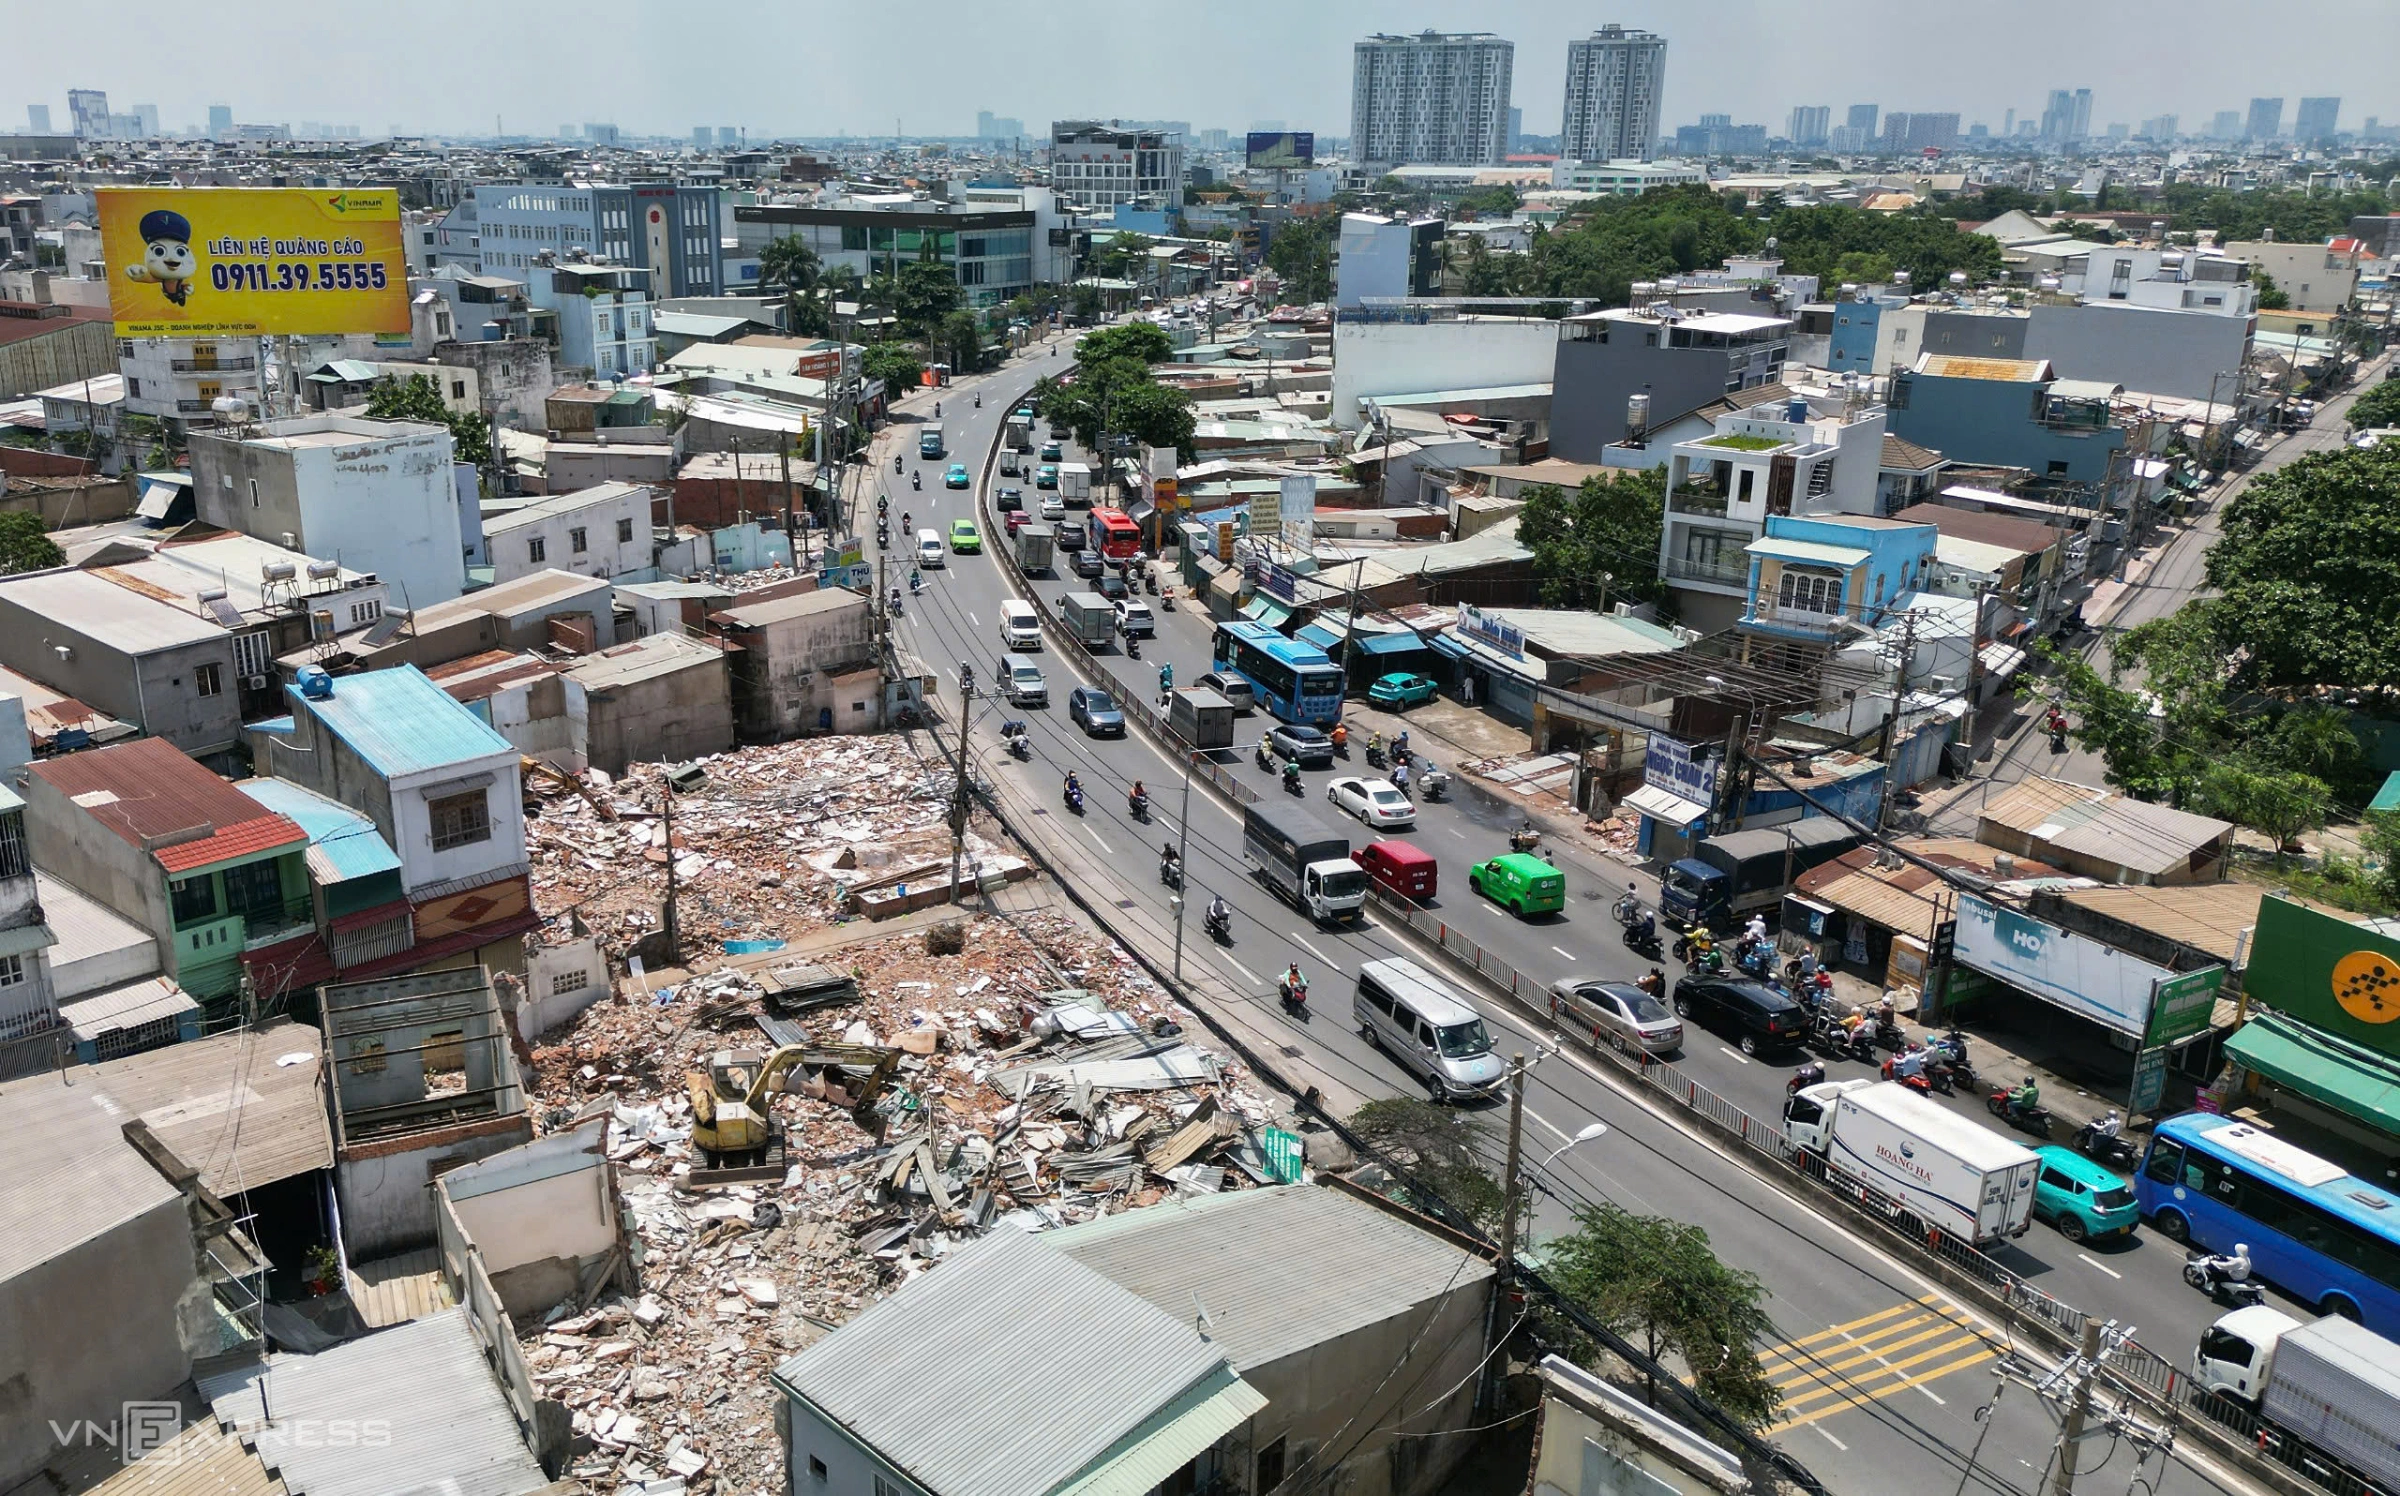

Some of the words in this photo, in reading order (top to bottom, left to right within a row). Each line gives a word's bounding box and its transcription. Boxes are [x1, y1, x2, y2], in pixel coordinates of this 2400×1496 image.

[208, 237, 245, 256] LIÊN
[249, 237, 270, 259] HỆ
[275, 236, 328, 257] QUẢNG
[333, 236, 364, 256] CÁO
[211, 262, 388, 291] 0911.39.5555
[851, 565, 869, 576] THÚ
[857, 577, 863, 585] Y
[1702, 772, 1713, 793] 2
[1876, 1144, 1914, 1172] HOANG
